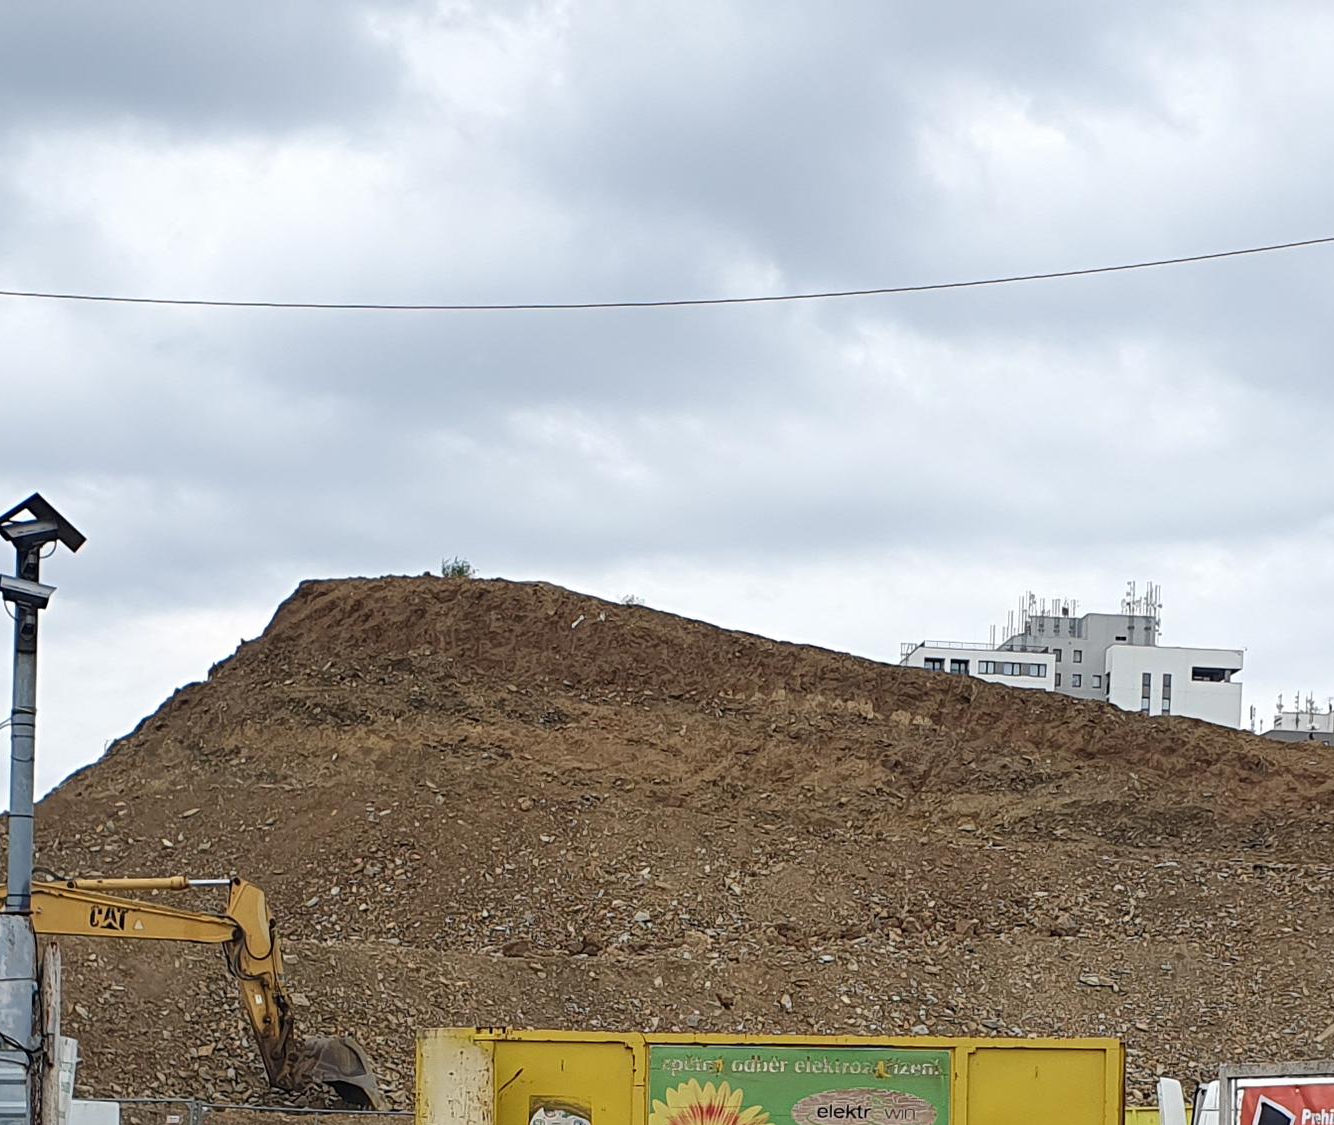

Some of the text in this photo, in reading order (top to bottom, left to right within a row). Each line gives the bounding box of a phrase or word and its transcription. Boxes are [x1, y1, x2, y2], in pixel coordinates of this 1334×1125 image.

[89, 905, 129, 930] CAT
[731, 1055, 788, 1074] odběr
[816, 1103, 916, 1120] elektrwin
